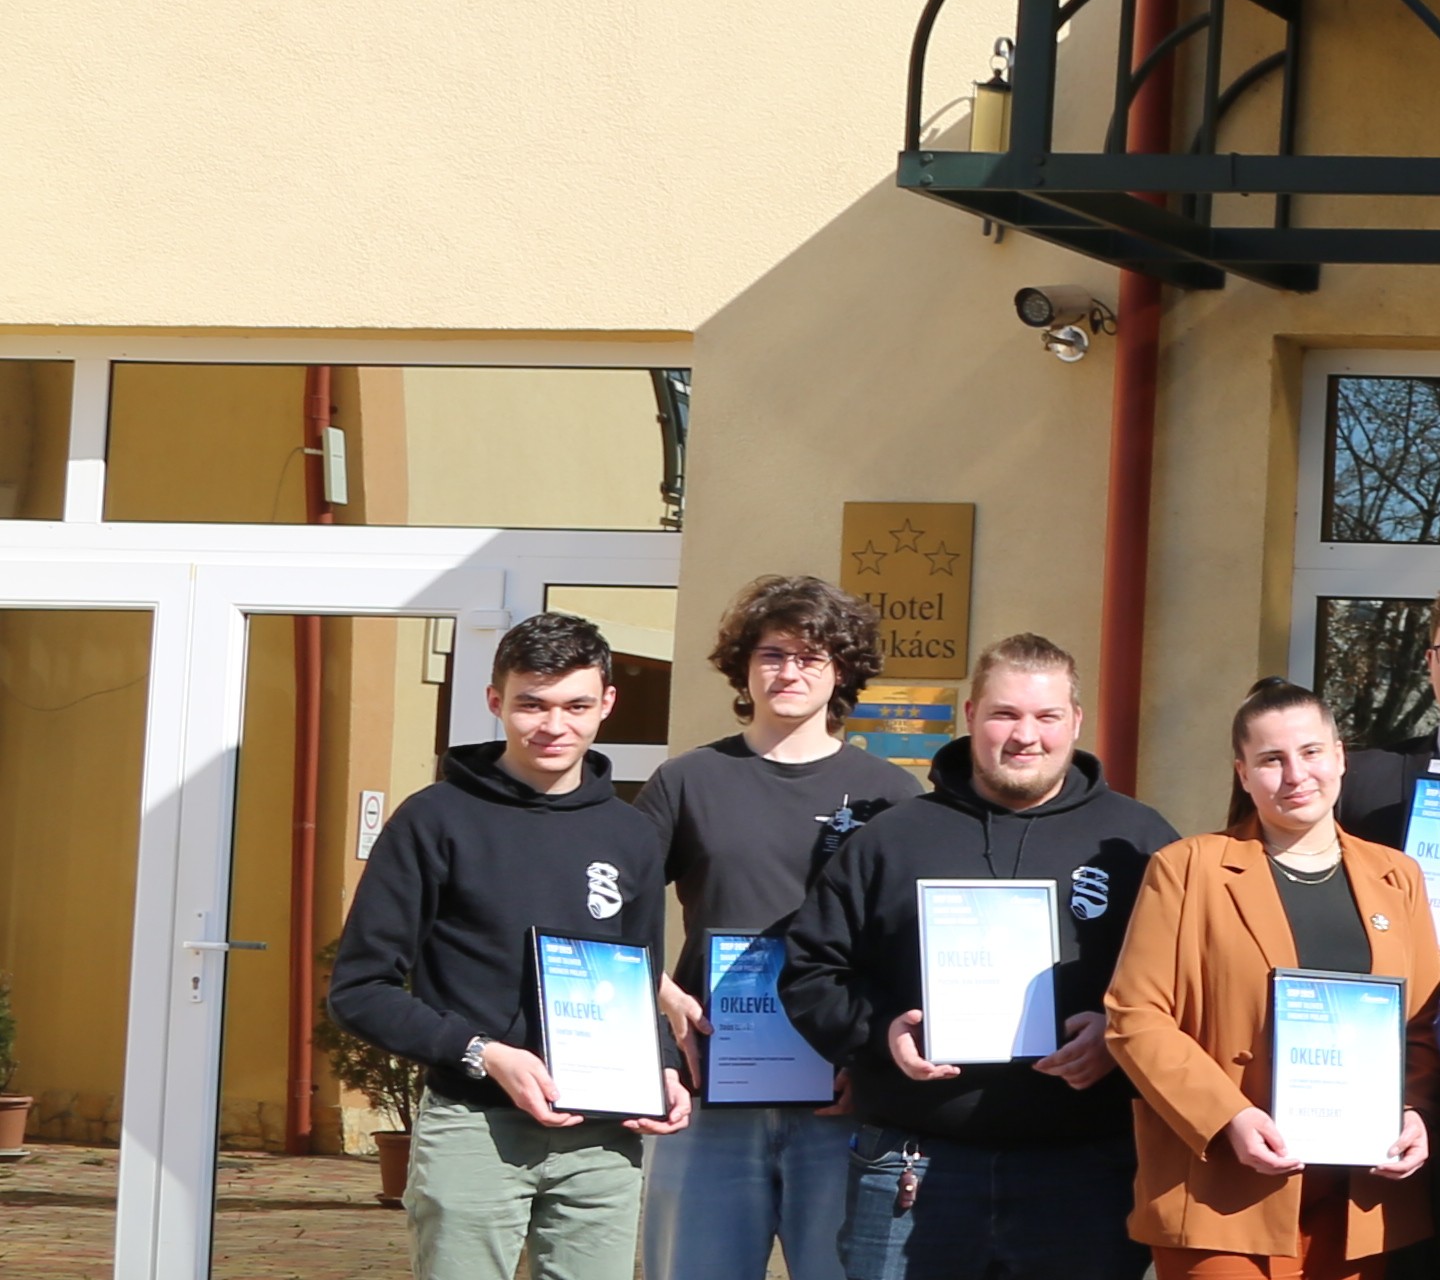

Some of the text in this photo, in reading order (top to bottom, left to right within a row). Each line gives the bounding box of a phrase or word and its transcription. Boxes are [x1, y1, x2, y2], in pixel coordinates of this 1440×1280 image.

[865, 592, 944, 621] Hotel
[878, 630, 956, 659] ukács
[554, 1000, 604, 1021] OKLEVÉL
[720, 993, 777, 1014] OKLEVÉL
[1290, 1044, 1343, 1067] OKLEVÉL
